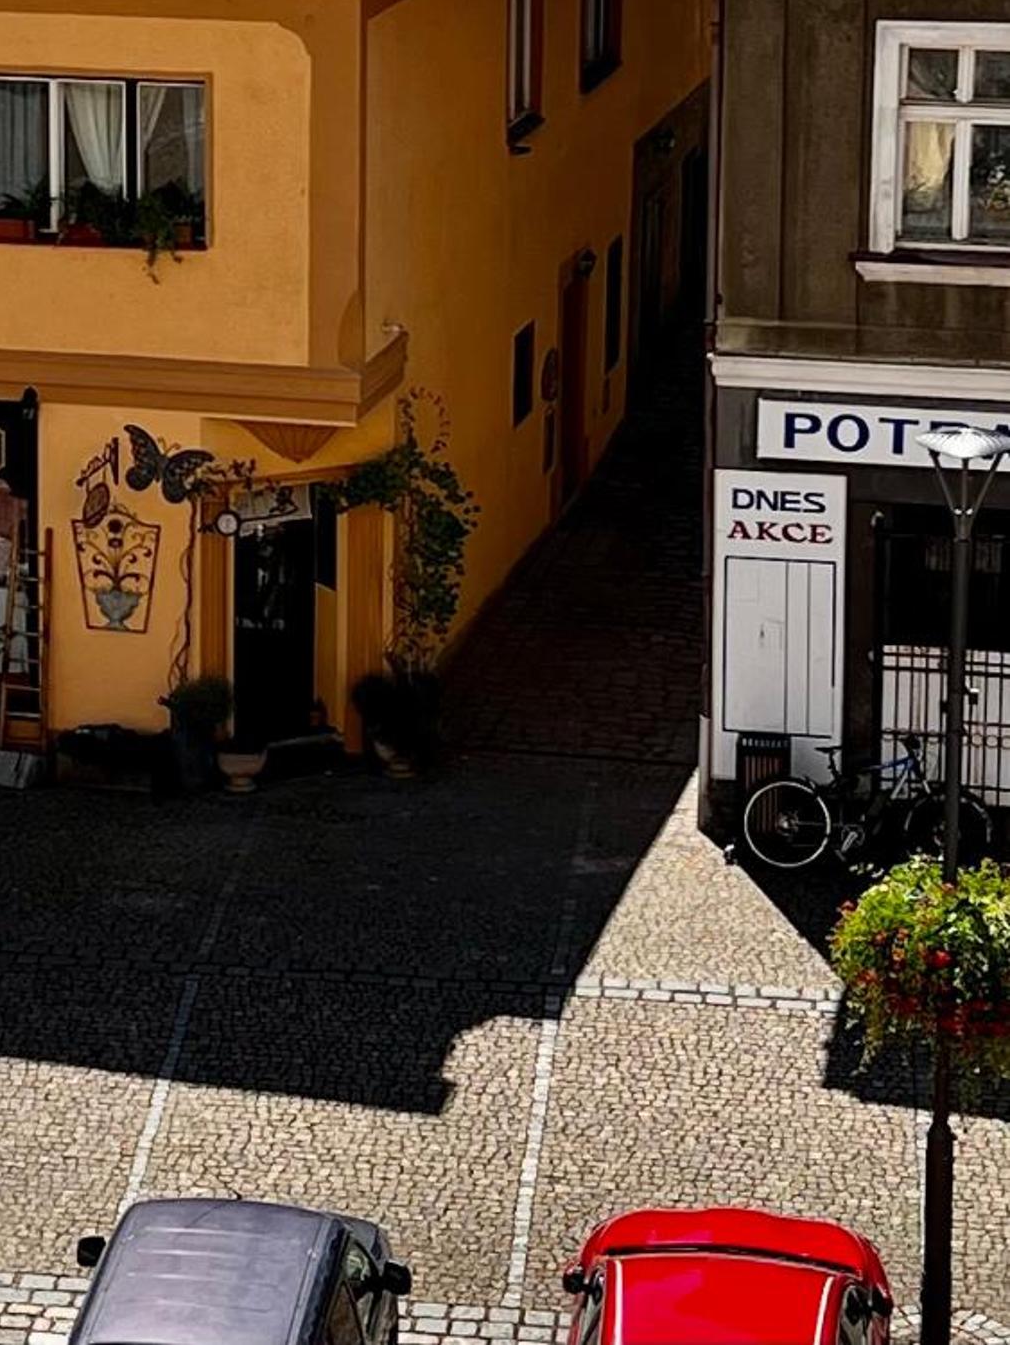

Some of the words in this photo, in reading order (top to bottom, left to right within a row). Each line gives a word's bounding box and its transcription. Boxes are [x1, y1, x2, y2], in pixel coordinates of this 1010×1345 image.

[784, 412, 1010, 460] POT
[732, 488, 826, 513] DNES
[727, 520, 834, 544] AKCE
